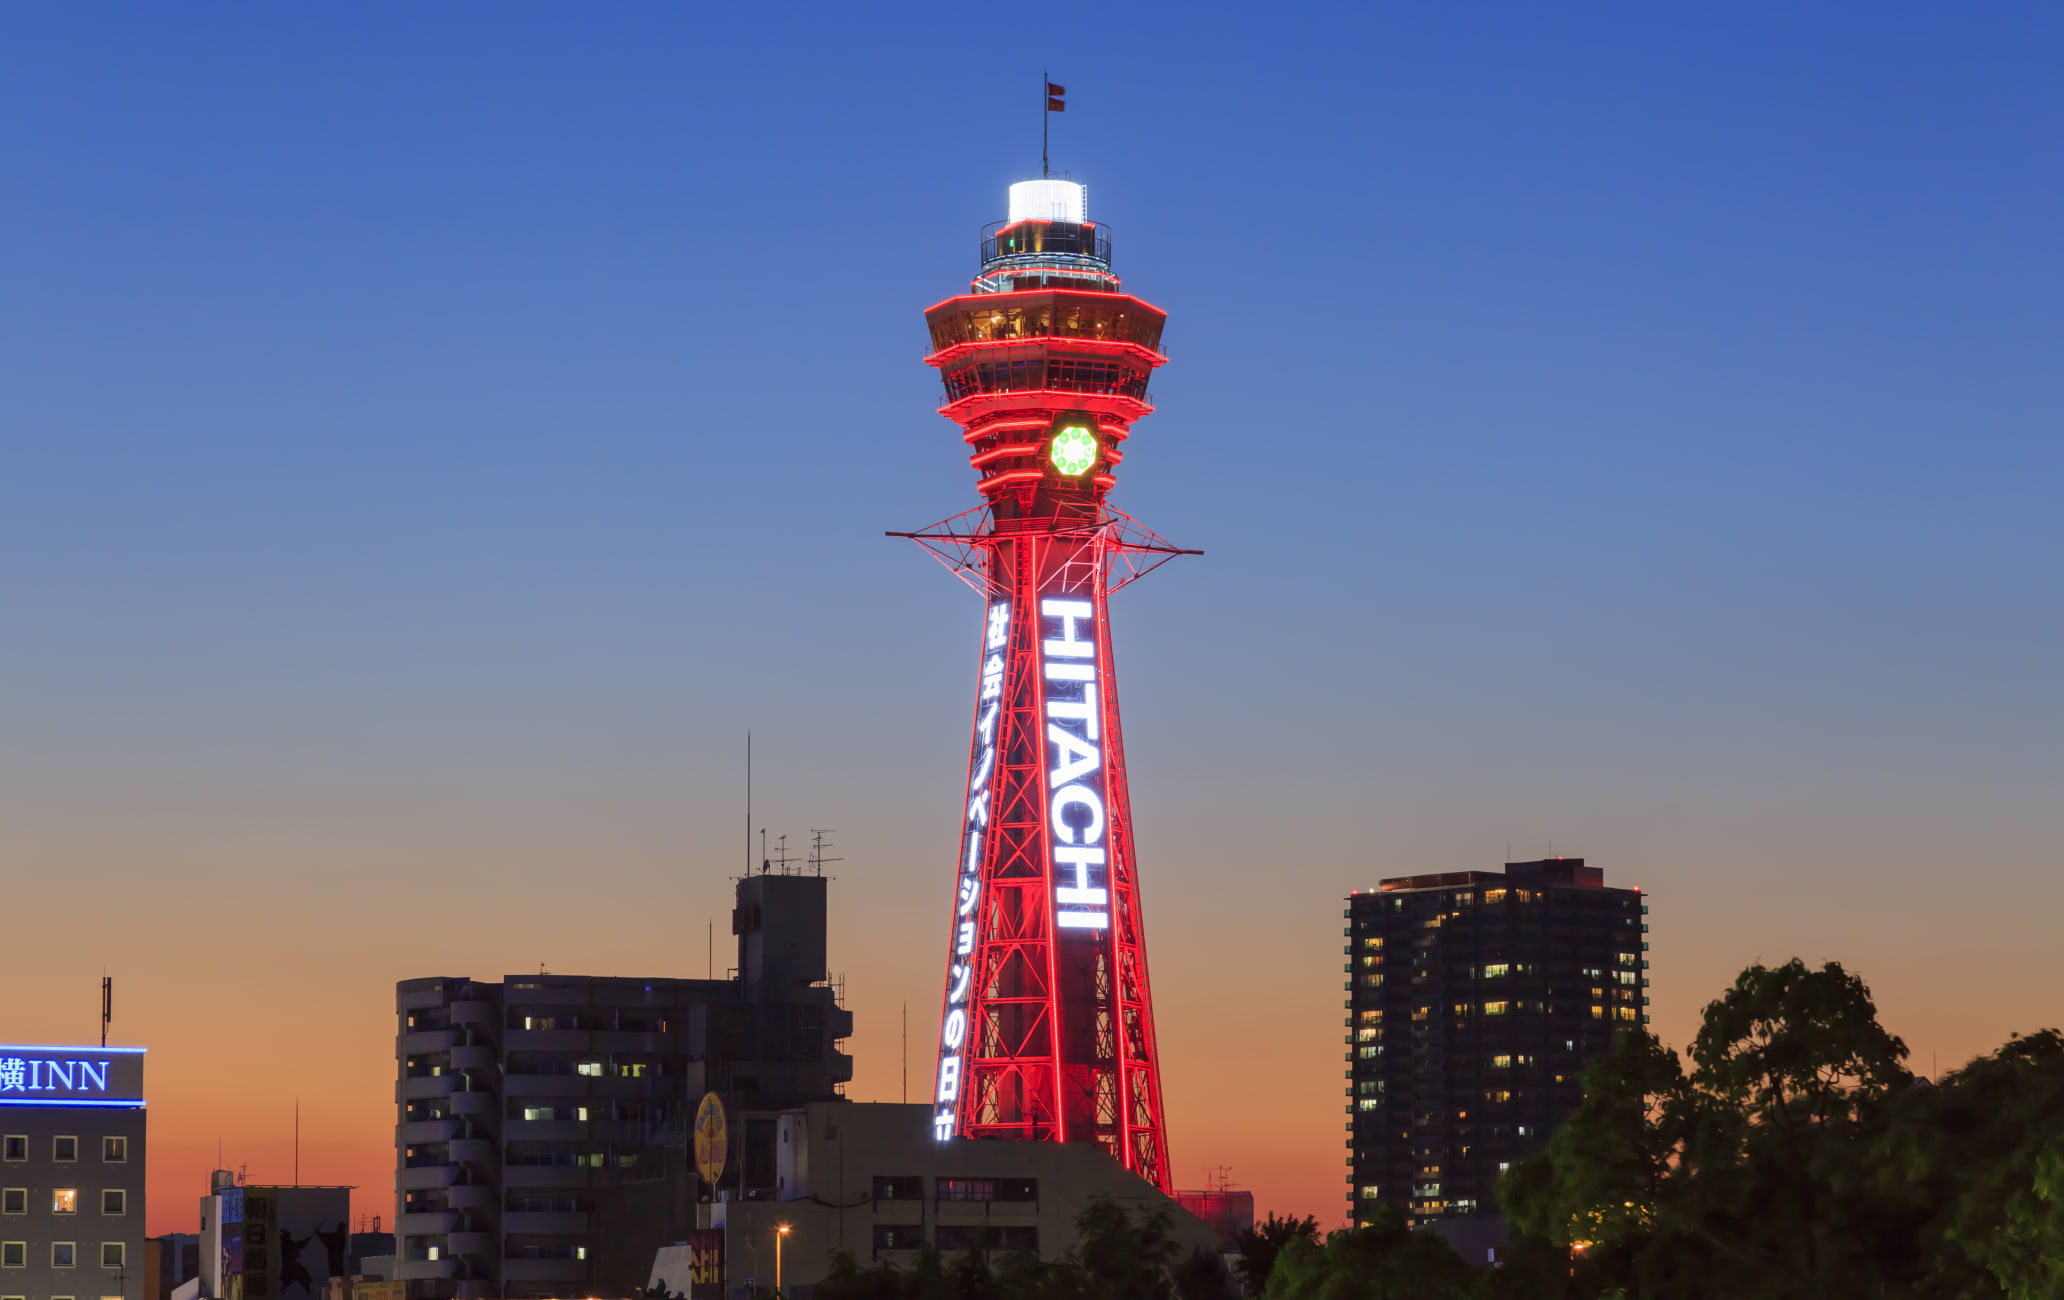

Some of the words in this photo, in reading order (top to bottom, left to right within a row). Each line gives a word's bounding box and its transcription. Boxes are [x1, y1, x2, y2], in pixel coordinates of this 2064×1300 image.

[935, 603, 1009, 1140] 社会イノベーションの日立
[1042, 599, 1108, 928] HITACHI
